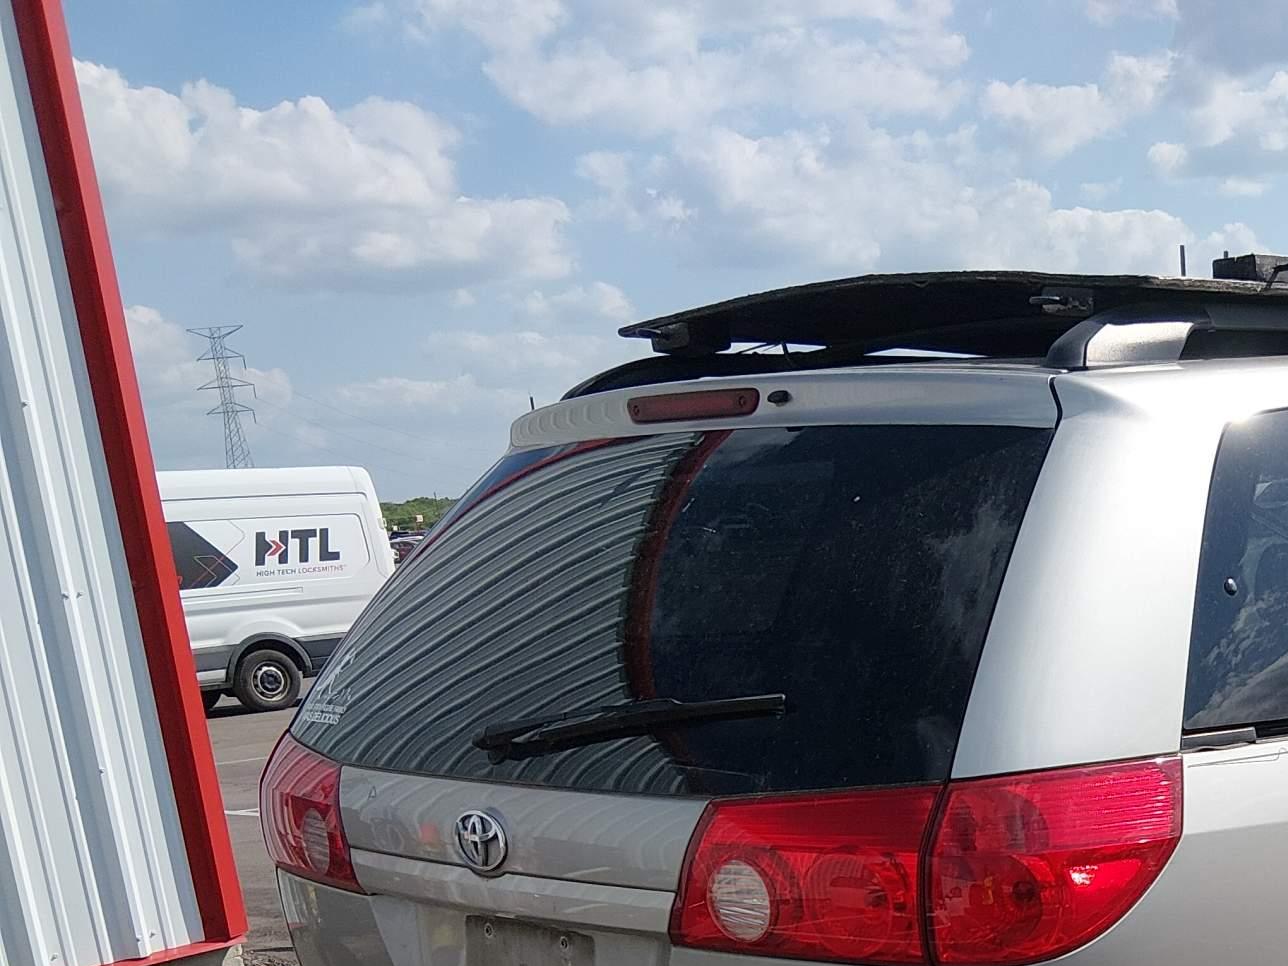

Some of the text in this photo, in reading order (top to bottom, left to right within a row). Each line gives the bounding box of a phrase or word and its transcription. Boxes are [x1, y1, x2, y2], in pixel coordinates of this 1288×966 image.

[255, 528, 340, 566] HTL
[256, 565, 344, 577] HIGH TECH LOCKSMITHS
